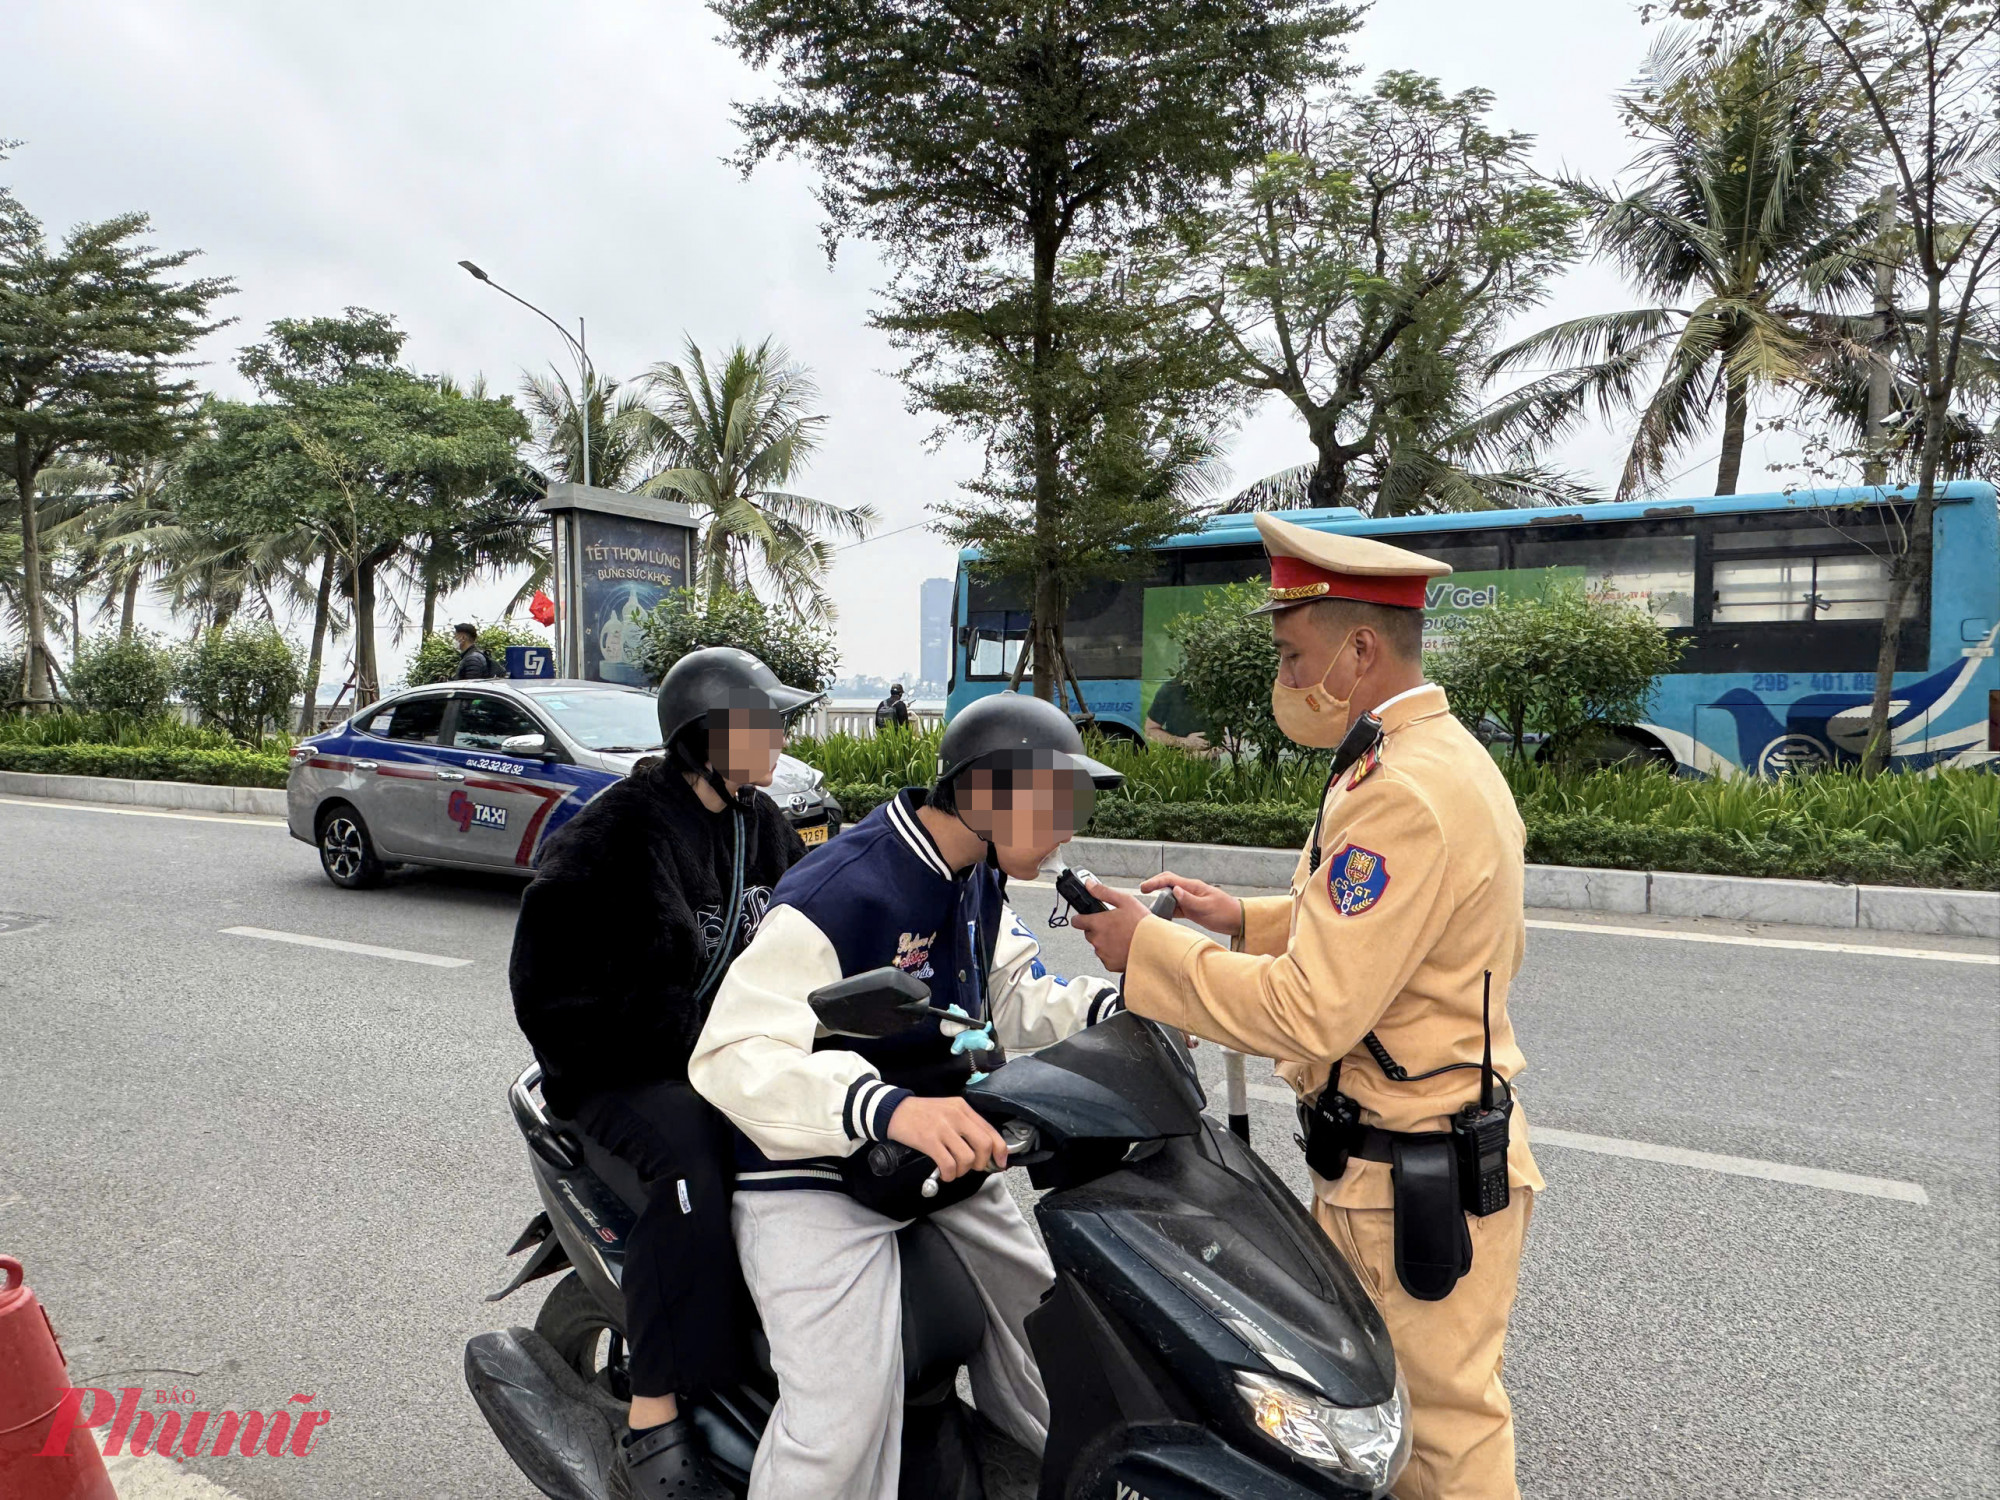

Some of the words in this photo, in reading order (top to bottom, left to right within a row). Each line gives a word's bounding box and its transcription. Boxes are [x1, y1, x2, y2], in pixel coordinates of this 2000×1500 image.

[585, 539, 610, 561] TẾT
[1451, 585, 1496, 609] Gel
[524, 650, 546, 676] G7
[1752, 674, 1789, 692] 29B
[475, 804, 506, 825] TAXI
